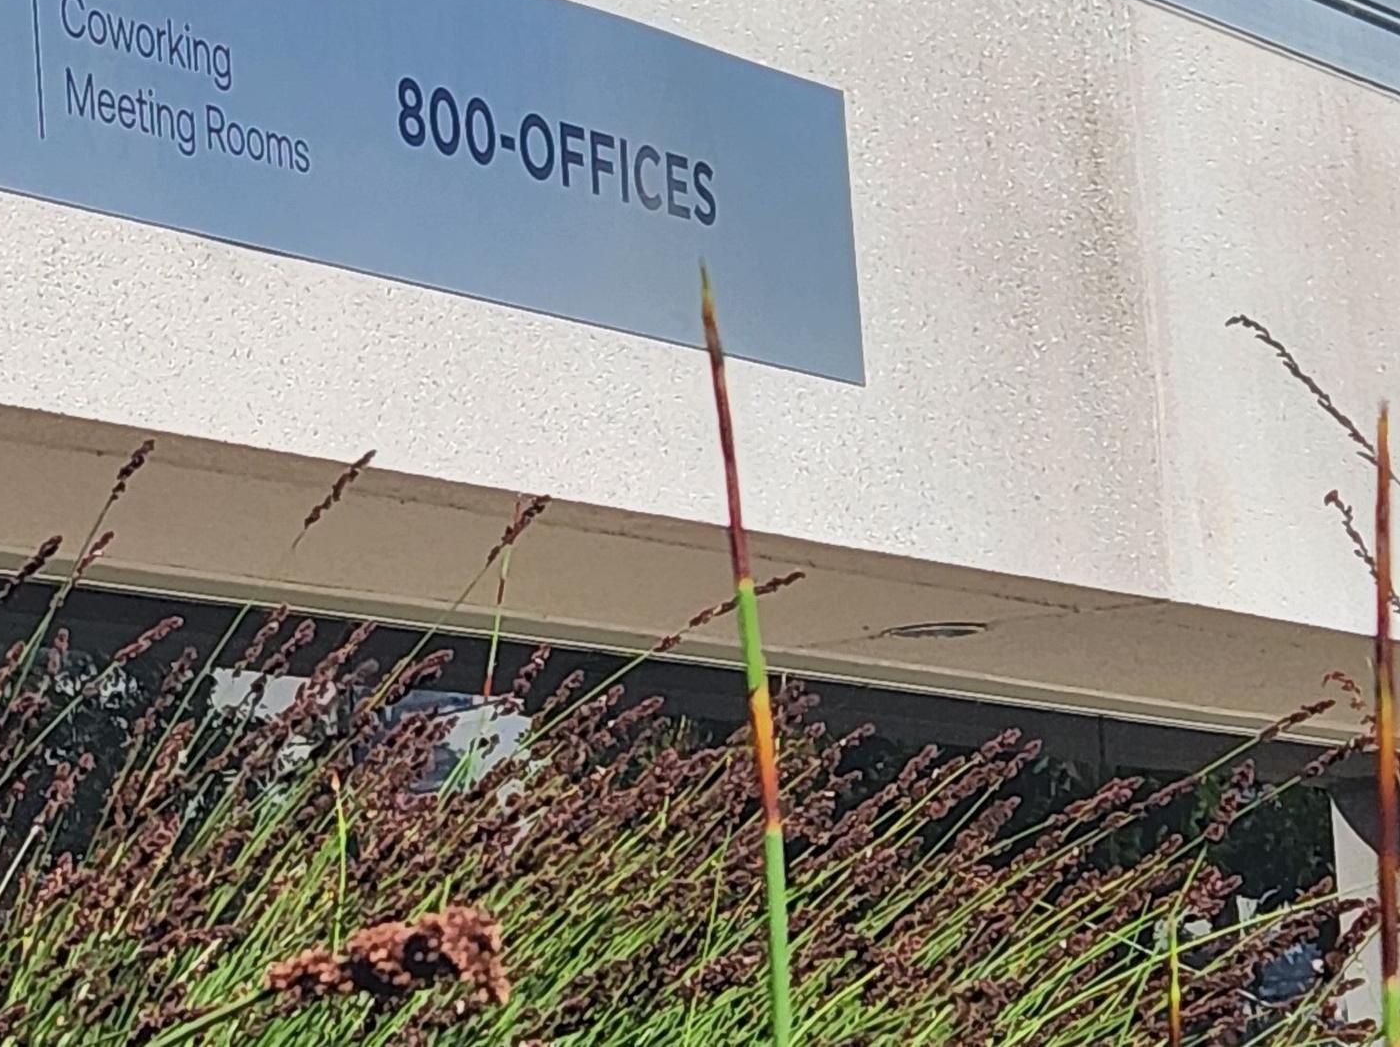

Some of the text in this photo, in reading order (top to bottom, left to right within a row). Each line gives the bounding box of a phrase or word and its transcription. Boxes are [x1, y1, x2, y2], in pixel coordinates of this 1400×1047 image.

[65, 67, 311, 173] Meeting Rooms
[398, 77, 717, 226] 800-OFFICES
